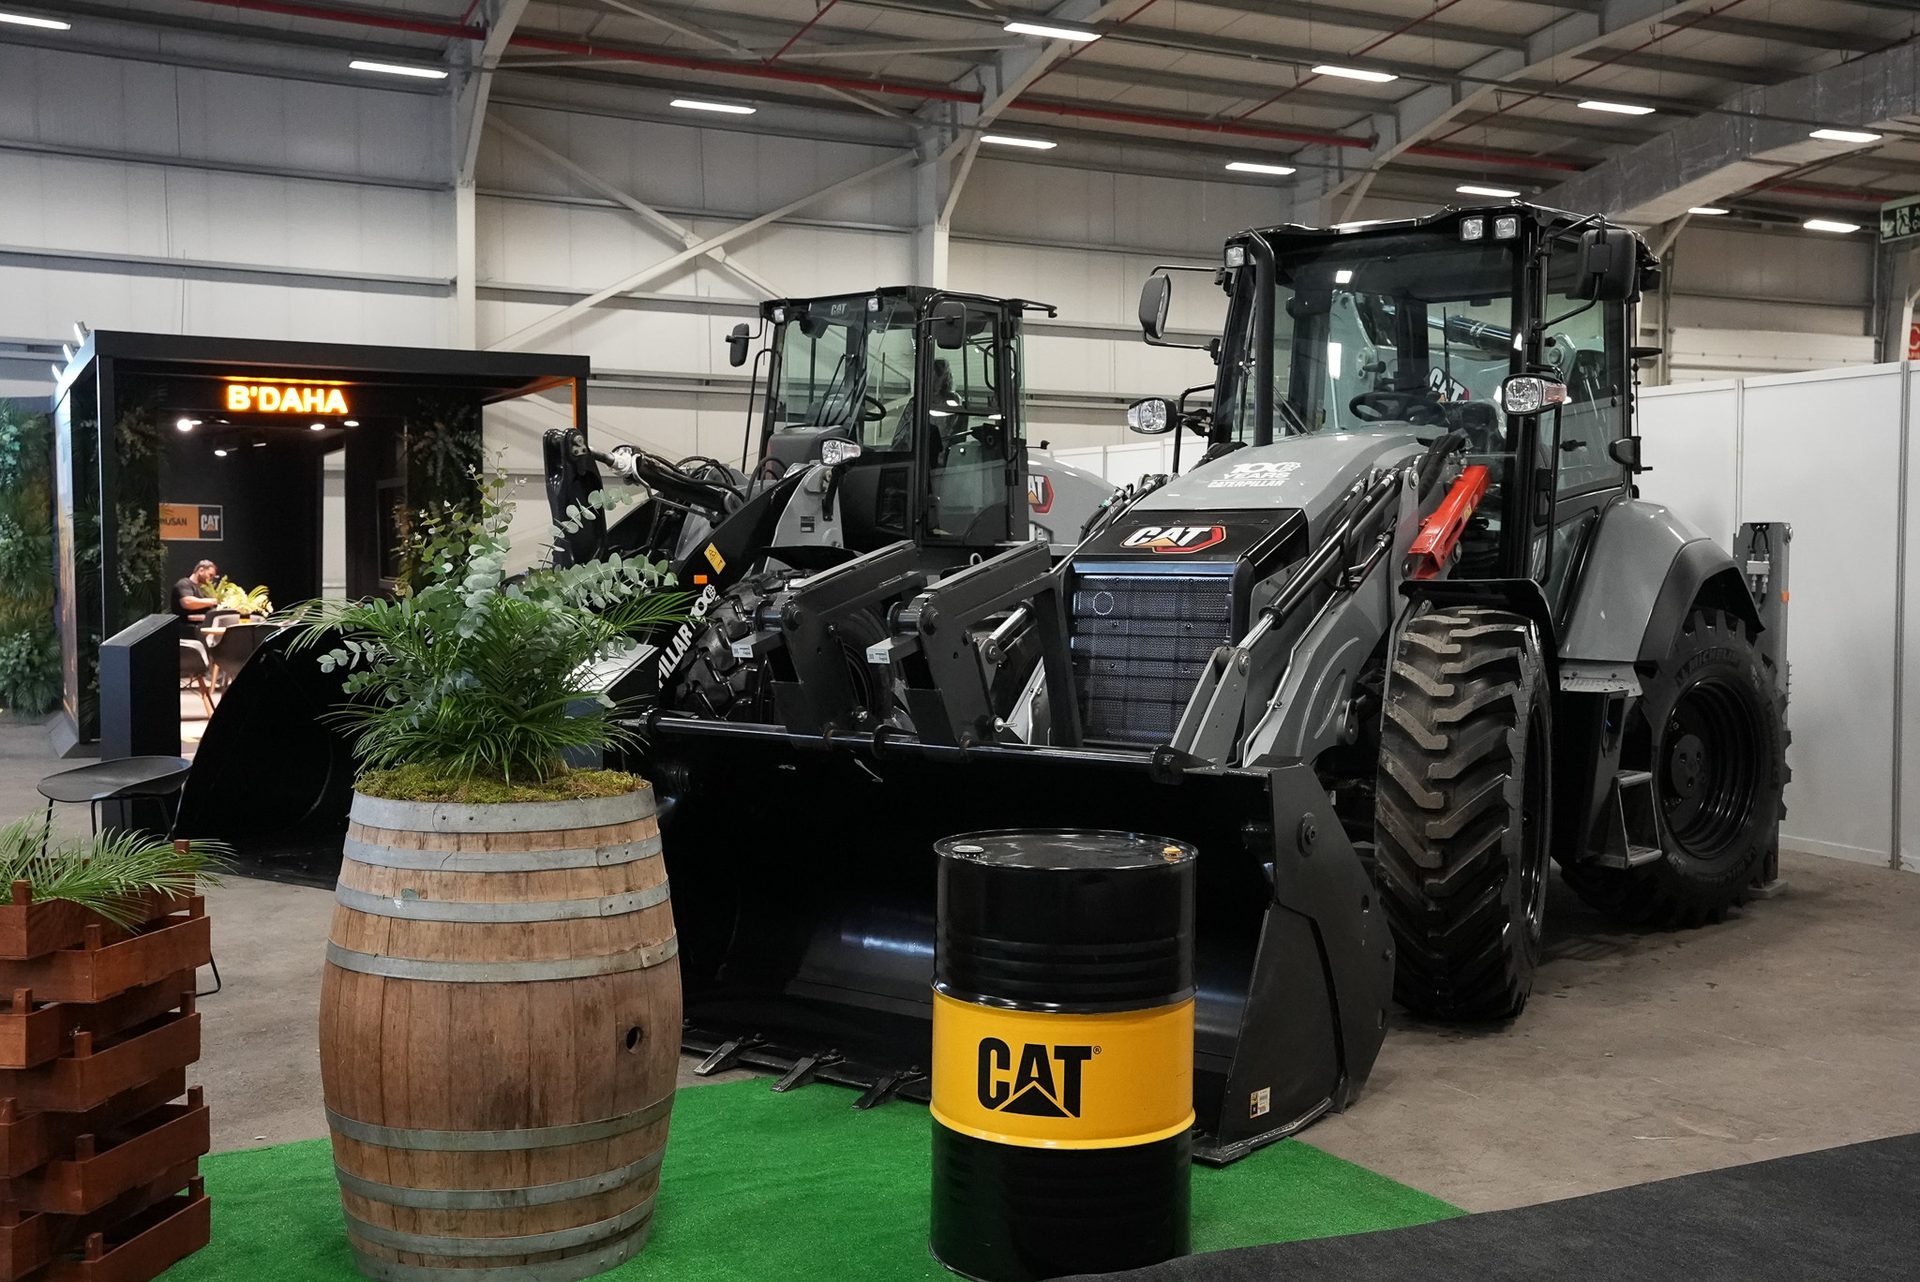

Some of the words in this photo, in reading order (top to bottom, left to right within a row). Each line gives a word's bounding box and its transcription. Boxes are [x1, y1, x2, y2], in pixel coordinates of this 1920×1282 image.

[830, 303, 848, 316] CAT
[227, 384, 349, 414] B'DAHA
[1207, 479, 1286, 488] CATERPILLAR
[1223, 472, 1292, 481] YEARS
[1027, 475, 1045, 505] AT
[200, 514, 220, 532] CAT
[1122, 526, 1213, 547] CAT
